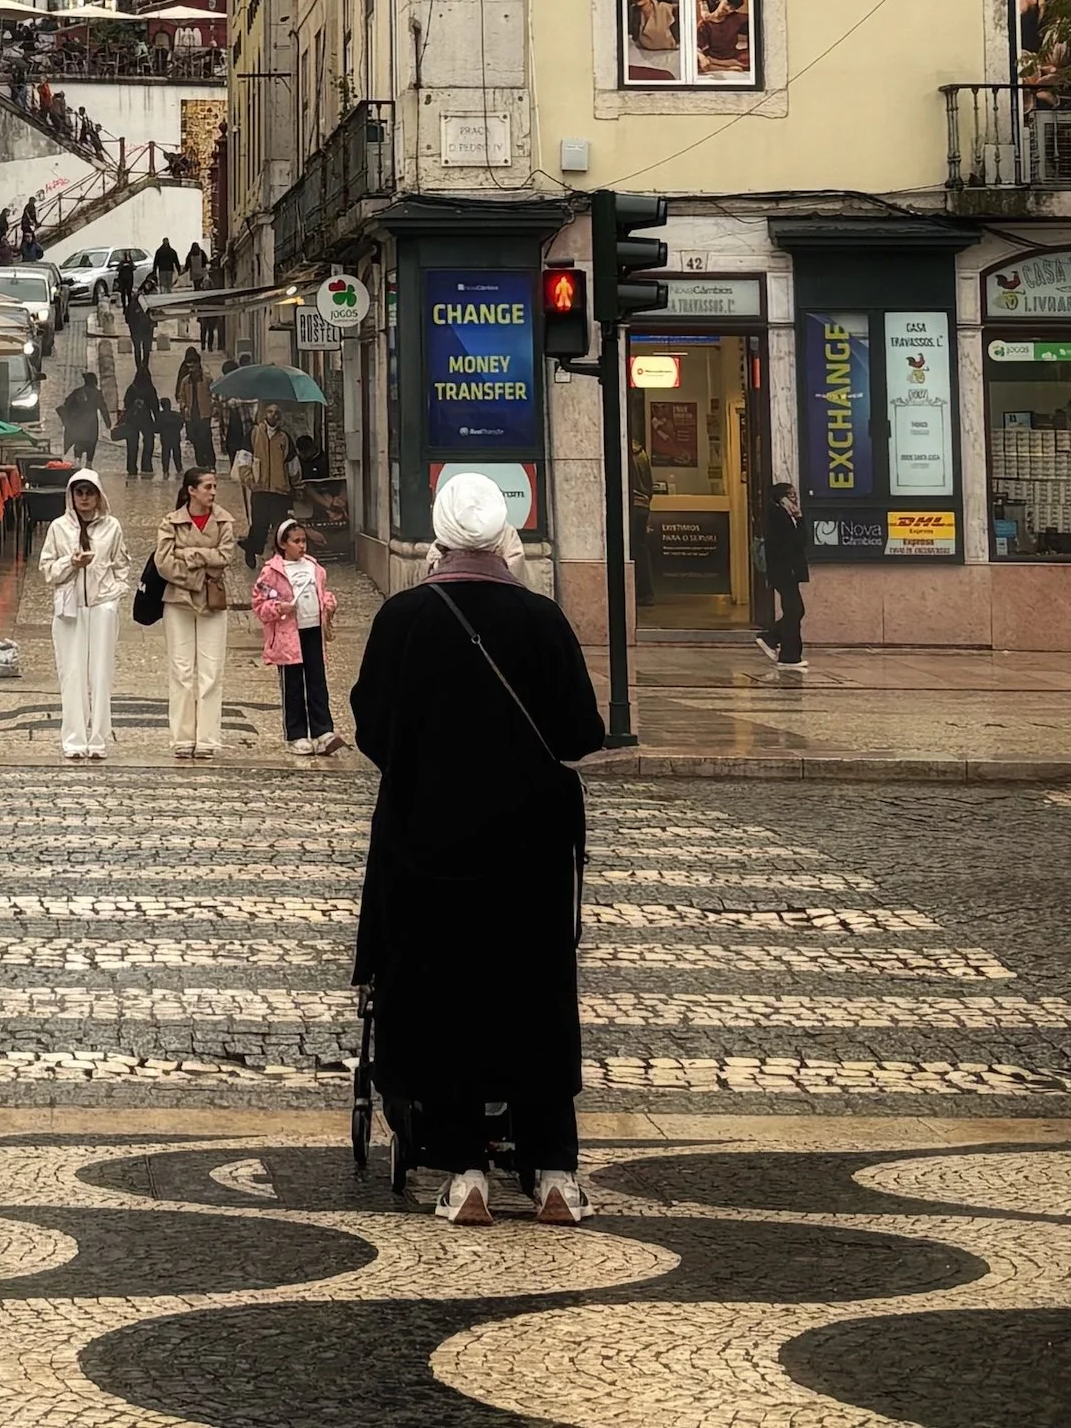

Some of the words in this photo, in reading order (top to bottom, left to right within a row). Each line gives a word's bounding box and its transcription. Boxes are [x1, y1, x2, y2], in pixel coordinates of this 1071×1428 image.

[686, 257, 703, 270] 42
[1022, 260, 1067, 288] CASA
[1024, 296, 1071, 312] LIVRA
[330, 309, 359, 320] JOGOS
[432, 303, 525, 325] CHANGE
[906, 323, 927, 333] CASA
[449, 355, 511, 373] MONEY
[434, 382, 528, 401] TRANSFER
[825, 323, 855, 489] EXCHANGE
[840, 521, 882, 536] Nova
[898, 516, 945, 527] DHL
[841, 535, 883, 546] Câmbios
